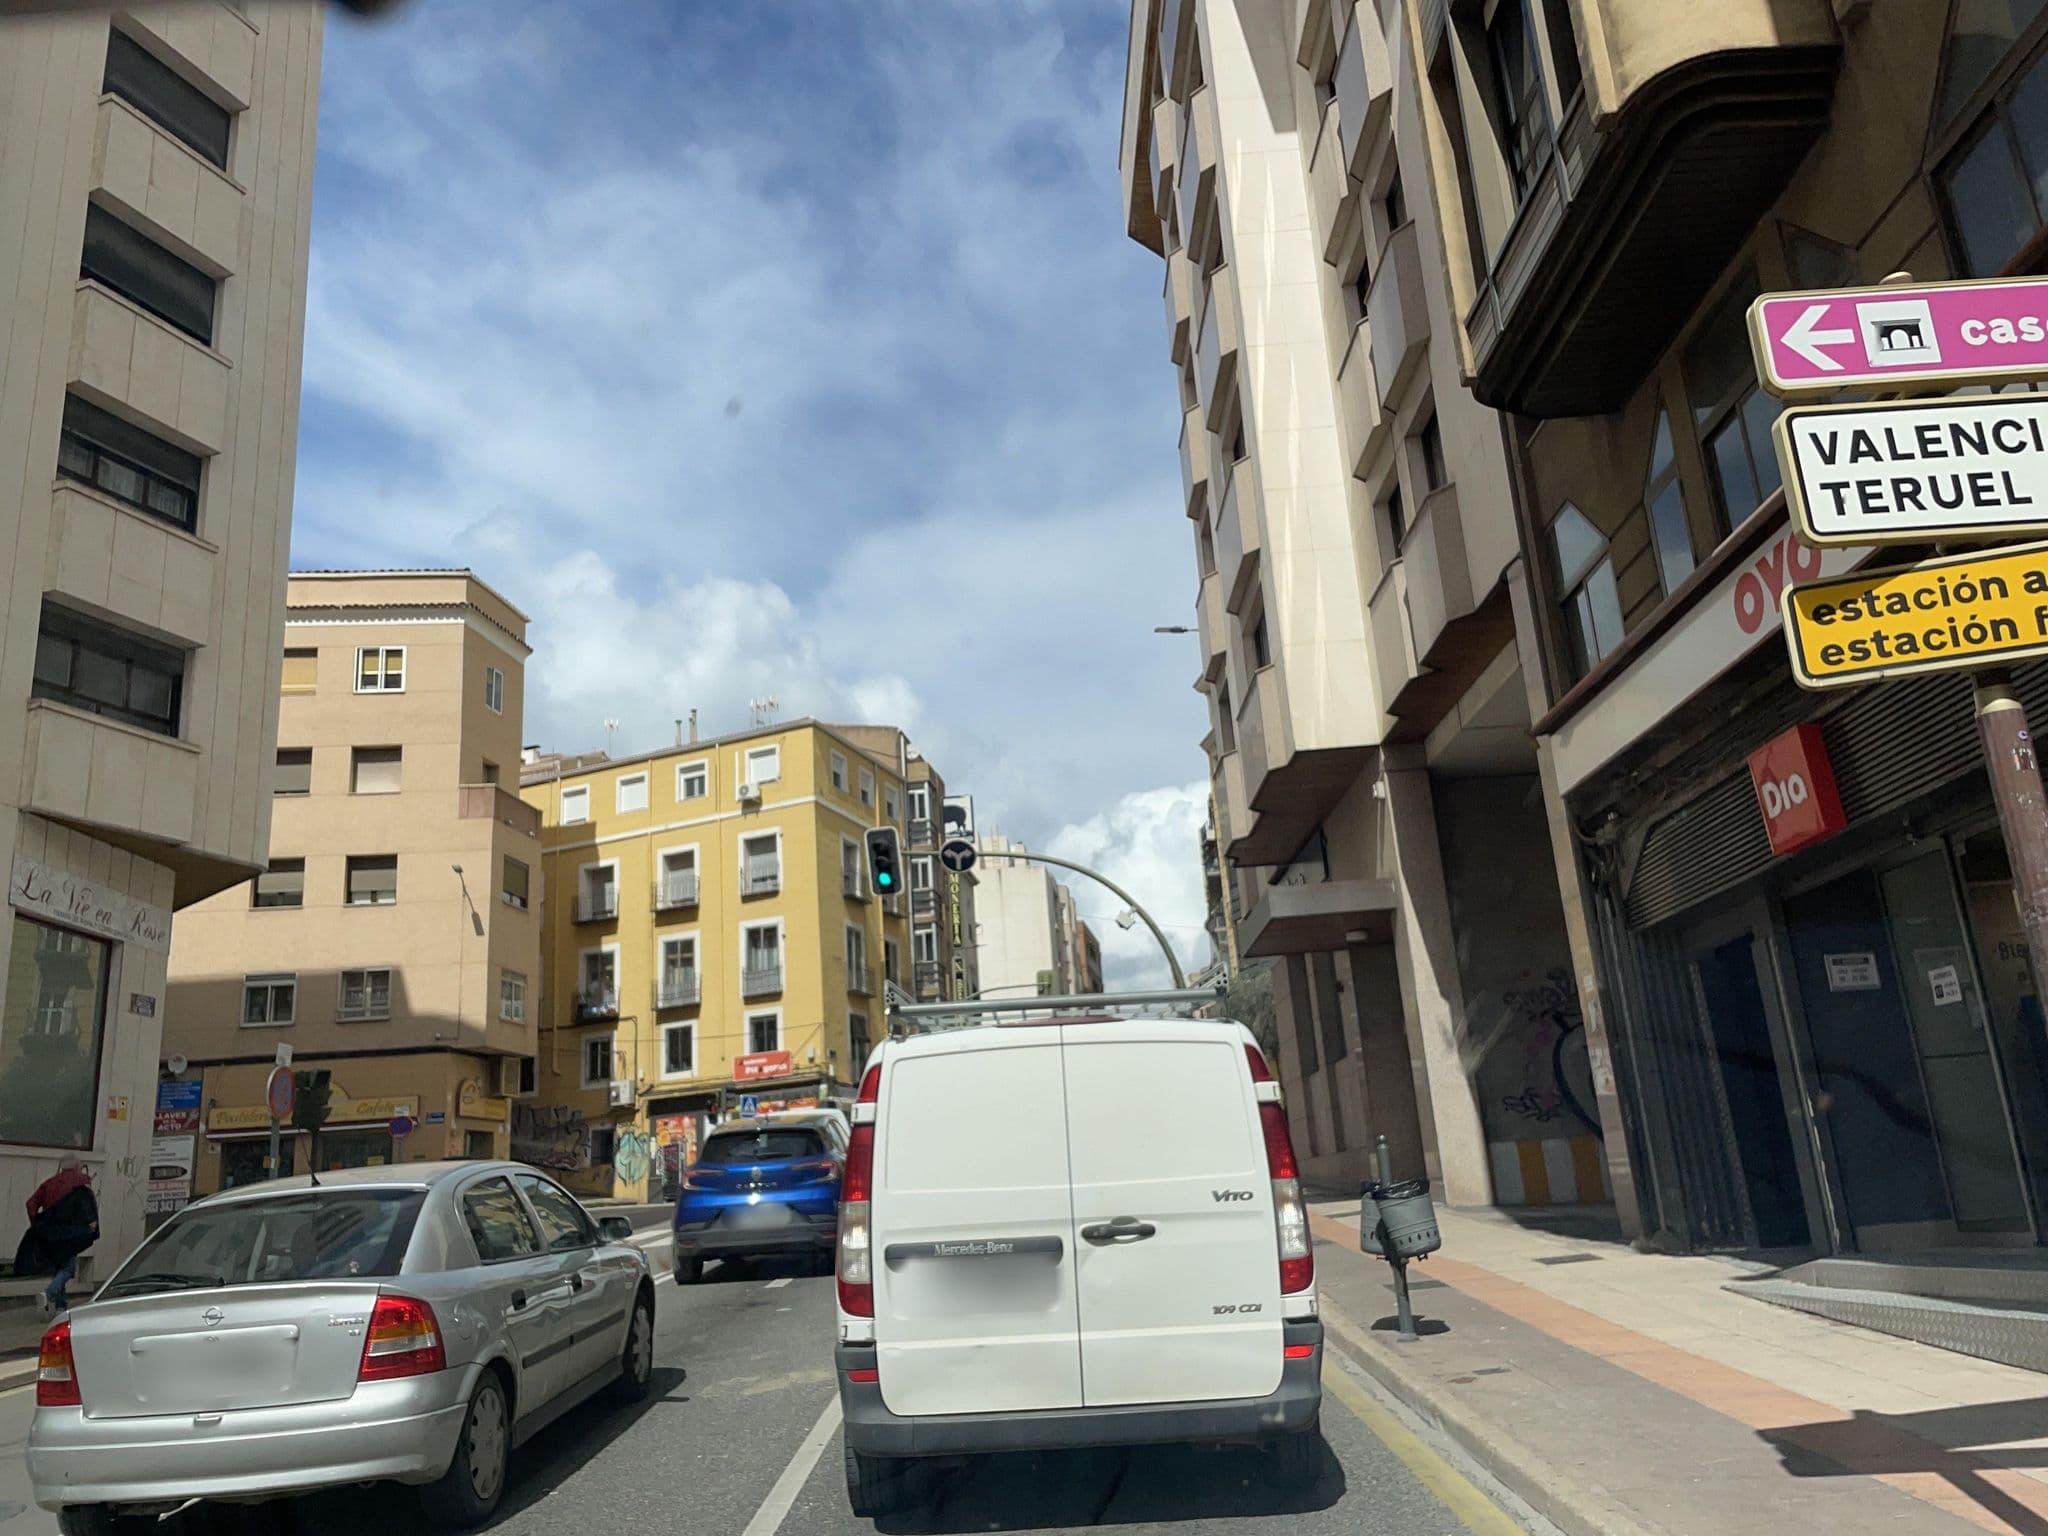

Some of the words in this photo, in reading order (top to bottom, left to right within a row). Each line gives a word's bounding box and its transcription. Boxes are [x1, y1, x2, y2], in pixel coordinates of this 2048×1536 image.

[1960, 315, 2048, 346] cas
[1808, 418, 2045, 465] VALENCI
[1819, 470, 2033, 516] TERUEL
[1812, 573, 2009, 625] estación
[2022, 570, 2048, 594] a
[1820, 614, 2019, 666] estación
[16, 866, 52, 905] La
[95, 910, 113, 926] en
[935, 1241, 1014, 1256] Mercedes-Benz
[1212, 1304, 1236, 1315] 109
[1238, 1303, 1263, 1313] CDI
